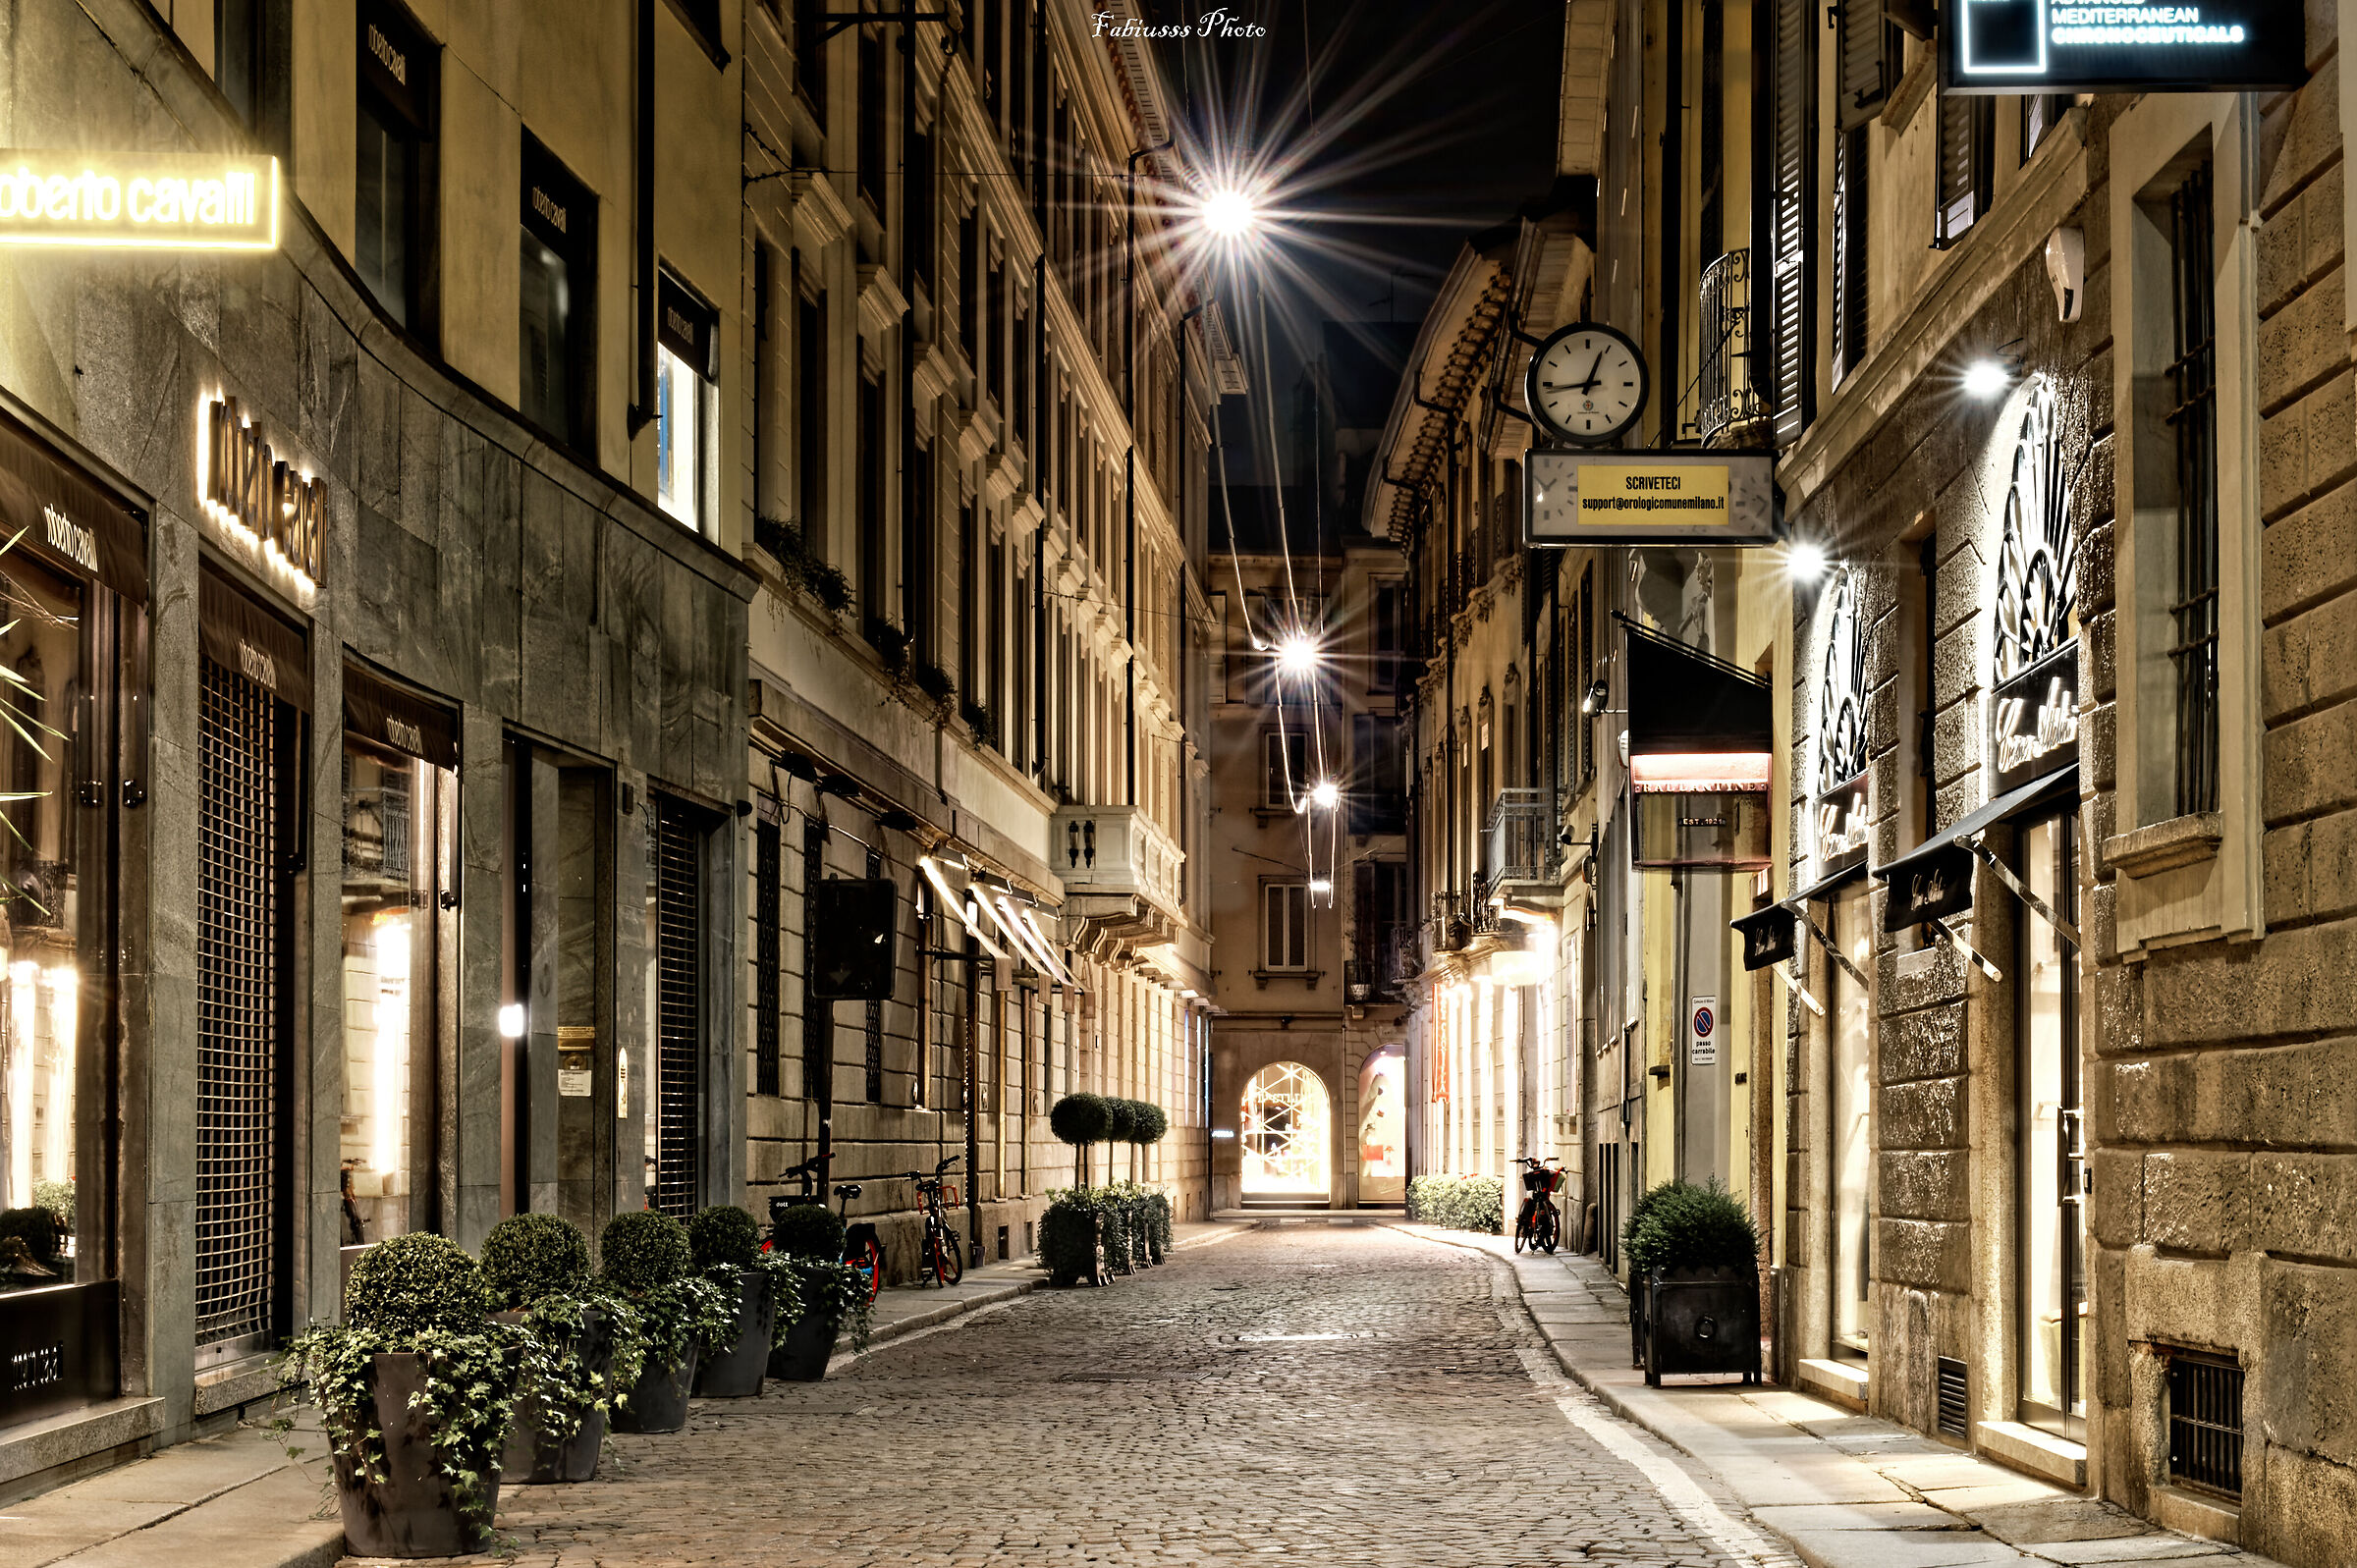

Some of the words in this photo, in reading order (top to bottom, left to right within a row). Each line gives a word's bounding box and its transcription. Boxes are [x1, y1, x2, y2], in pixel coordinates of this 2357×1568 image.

[2052, 8, 2199, 24] MEDITERRANEAN
[2051, 26, 2245, 44] CHRONOCEUTICALS
[128, 171, 255, 225] cavalli
[1625, 476, 1681, 490] SCRIVETECI
[1582, 496, 1725, 511] support@orologicomunemilano.it
[44, 503, 74, 558] roberto
[74, 523, 98, 572] cavalli
